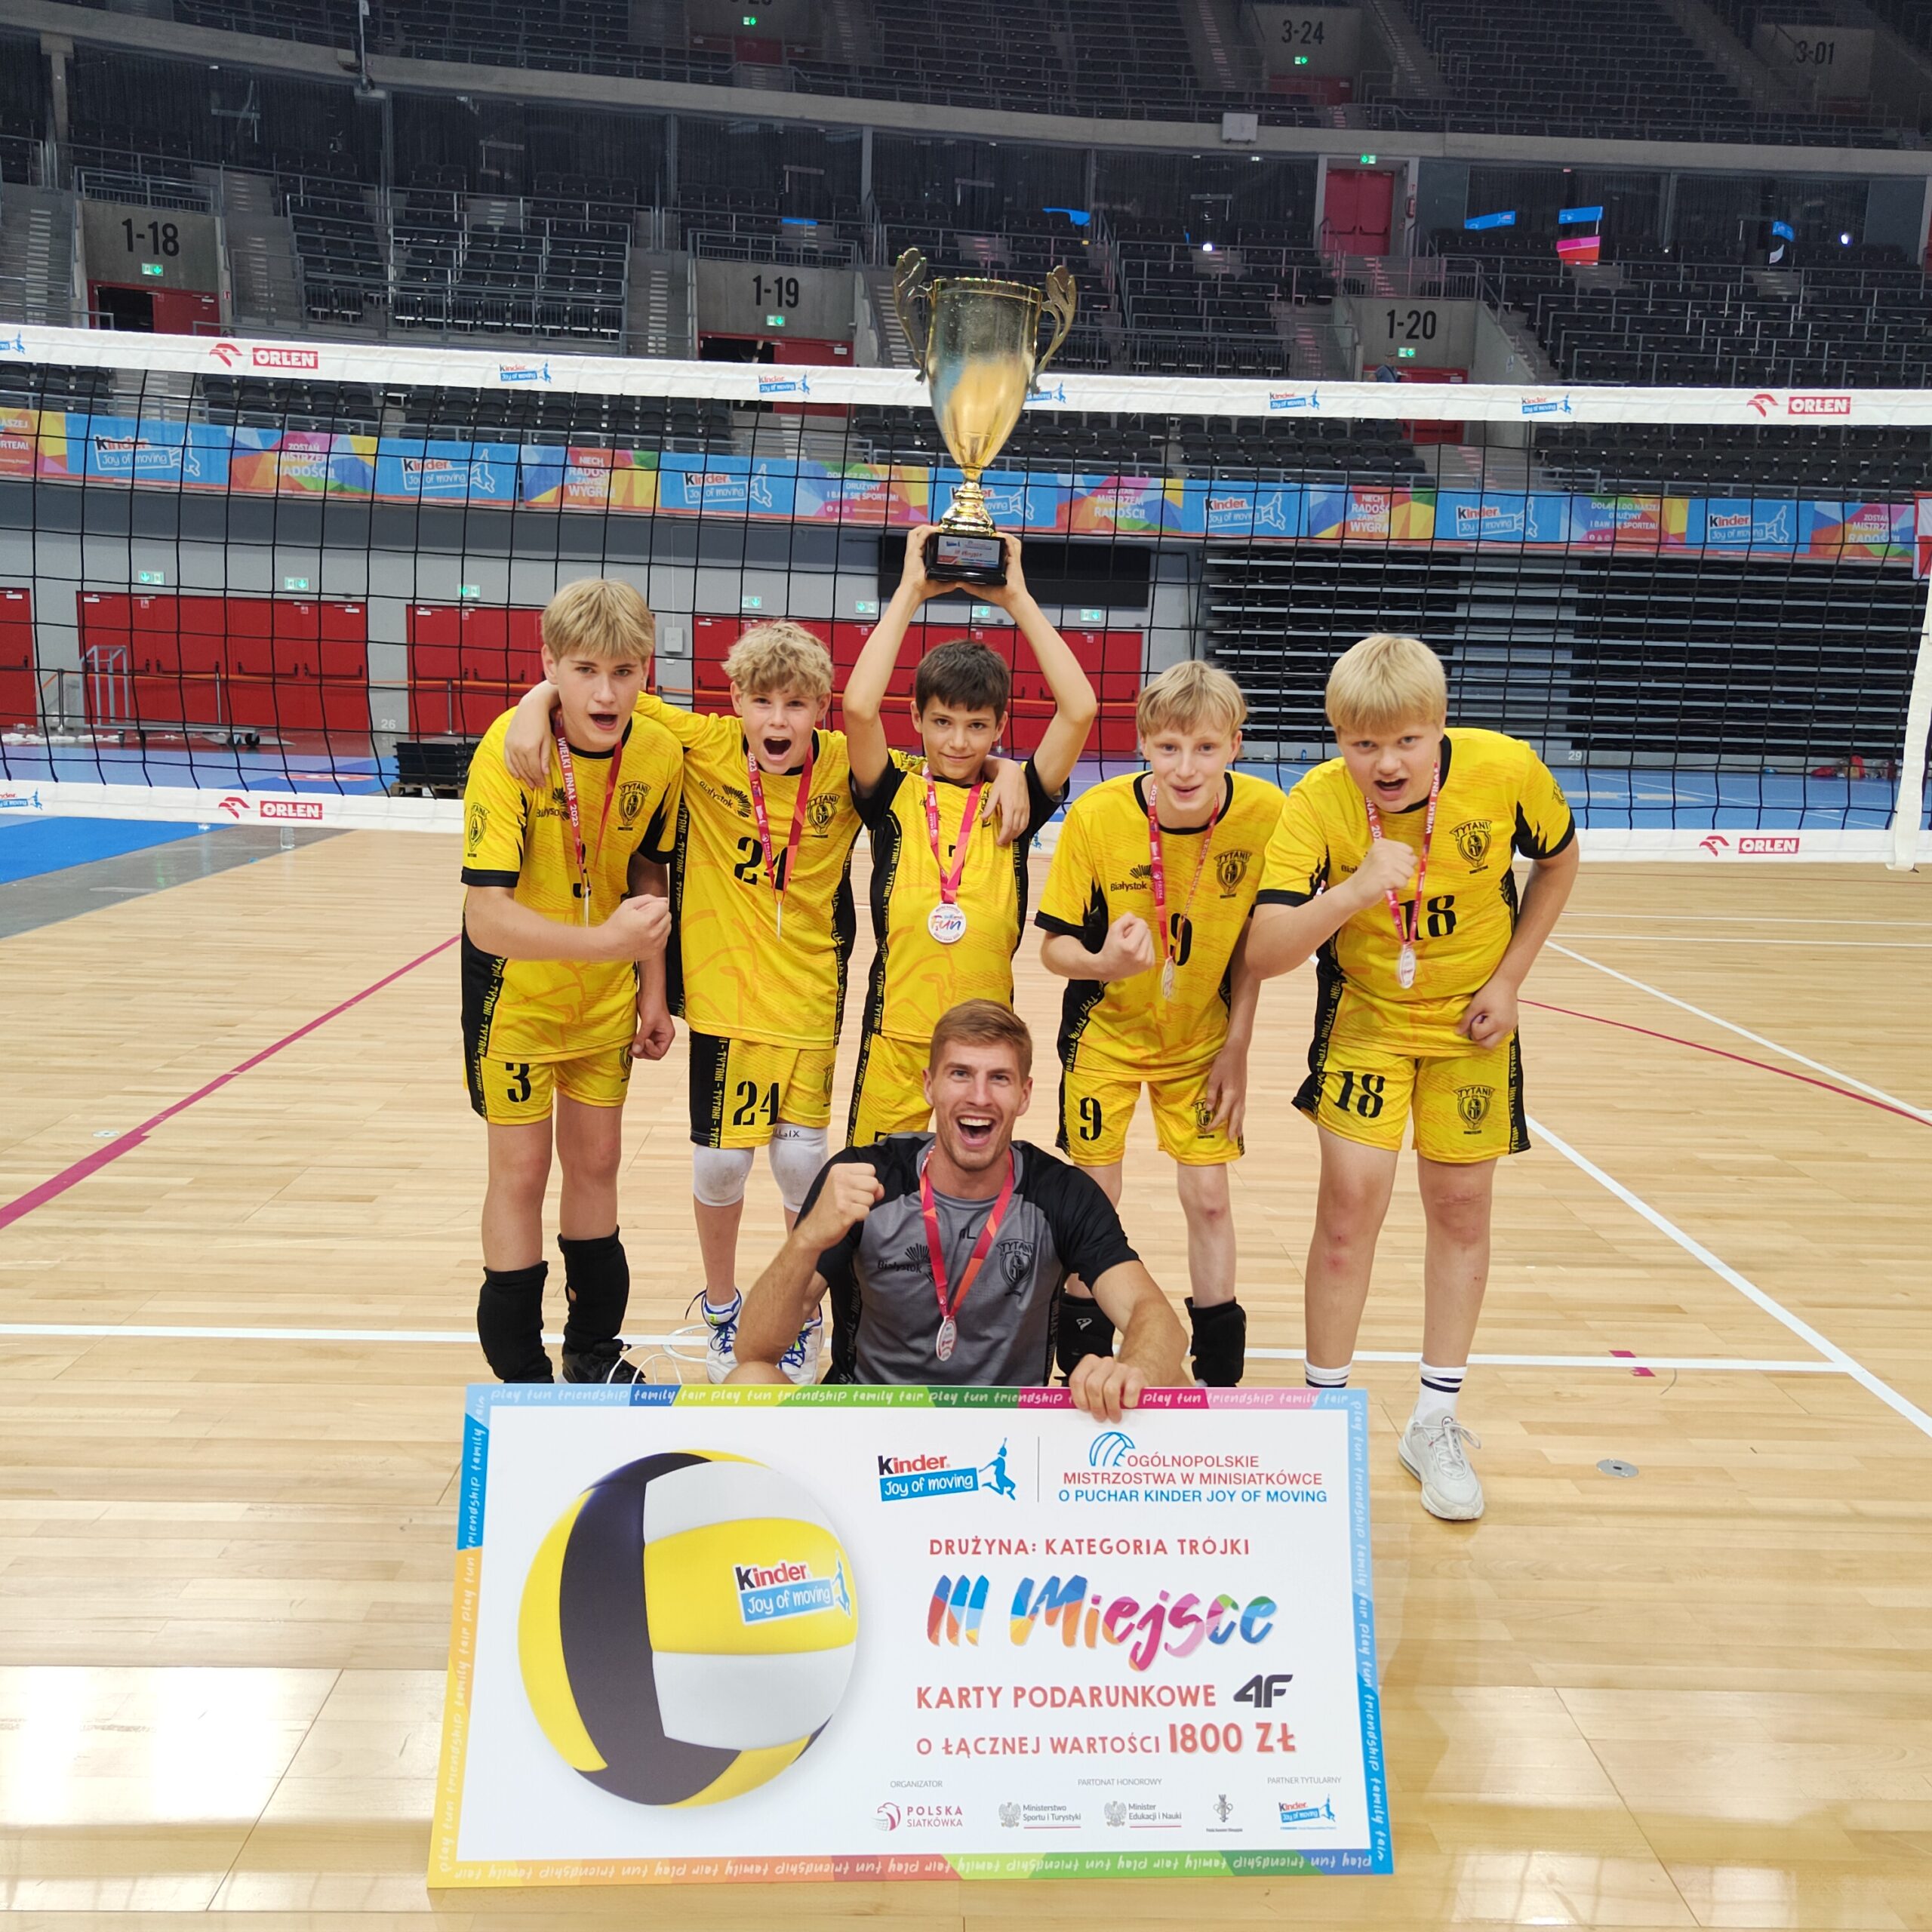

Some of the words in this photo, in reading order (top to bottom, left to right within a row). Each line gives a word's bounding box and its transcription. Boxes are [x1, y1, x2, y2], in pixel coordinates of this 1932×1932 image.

[1282, 20, 1324, 45] 3-24
[122, 217, 180, 257] 1-18
[752, 274, 800, 309] 1-19
[1386, 309, 1437, 340] 1-20
[255, 349, 315, 367] ORLEN
[1790, 398, 1848, 413] ORLEN
[103, 454, 120, 467] Joy
[404, 458, 448, 472] kinder
[436, 472, 466, 485] moving
[685, 472, 730, 486] kinder
[717, 488, 745, 499] moving
[1204, 498, 1245, 512] kinder
[1457, 506, 1498, 519] kinder
[1709, 515, 1749, 528] kinder
[1737, 528, 1763, 538] movng
[380, 718, 396, 730] 26
[557, 737, 571, 768] WIELKI
[1568, 750, 1583, 761] 29
[565, 772, 577, 801] FINAŁ
[621, 783, 648, 793] TYTANI
[263, 802, 320, 820] ORLEN
[570, 804, 579, 827] 2023
[1426, 801, 1436, 834] WIELKI
[1454, 821, 1491, 837] TYTANI
[1743, 838, 1796, 852] ORLEN
[1214, 851, 1251, 863] TYTANI
[1110, 879, 1147, 892] Białystok
[1398, 895, 1457, 943] 18
[1169, 912, 1192, 967] 9
[714, 1051, 727, 1081] TYTANI
[505, 1063, 531, 1103] 3
[1336, 1070, 1386, 1118] 18
[1458, 1087, 1491, 1097] TYTANI
[711, 1089, 723, 1119] TYTANI
[732, 1081, 780, 1126] 24
[1079, 1097, 1102, 1141] 9
[999, 1241, 1034, 1254] TYTANI
[634, 1389, 676, 1402] family
[711, 1390, 740, 1404] play
[777, 1389, 847, 1403] friendship
[853, 1390, 894, 1404] family
[899, 1390, 924, 1401] fair
[928, 1392, 958, 1405] play
[964, 1392, 989, 1403] fun
[993, 1392, 1063, 1405] friendship
[1143, 1393, 1172, 1407] play
[1177, 1393, 1201, 1404] fun
[877, 1453, 949, 1476] kinder
[1127, 1451, 1260, 1469] OGÓLNOPOLSKIE
[884, 1478, 910, 1498] Joy
[911, 1475, 925, 1493] of
[928, 1472, 974, 1491] moving
[1063, 1472, 1177, 1486] MISTRZOSTWA
[1180, 1472, 1196, 1485] W
[1198, 1468, 1323, 1486] MINISIATKÓWCE
[1058, 1489, 1070, 1503] O
[1074, 1489, 1140, 1503] PUCHAR
[1144, 1489, 1202, 1503] KINDER
[1205, 1489, 1237, 1503] JOY
[1241, 1489, 1262, 1503] OF
[1266, 1489, 1327, 1503] MOVING
[929, 1535, 1037, 1556] DRUŻYNA:
[1045, 1538, 1168, 1555] KATEGORIA
[1177, 1536, 1250, 1555] TRÓJKI
[735, 1562, 807, 1591] kinder
[747, 1596, 774, 1615] Joy
[776, 1589, 791, 1609] of
[793, 1586, 831, 1607] moving
[927, 1574, 989, 1647] III
[1009, 1574, 1278, 1672] Miejsce
[916, 1686, 1003, 1709] KARTY
[1013, 1684, 1217, 1709] PODARUNKOWE
[1233, 1674, 1294, 1709] 4F
[916, 1738, 932, 1755] O
[941, 1736, 1041, 1759] ŁĄCZNEJ
[1048, 1732, 1161, 1754] WARTOŚCI
[1168, 1722, 1244, 1754] 1800
[1255, 1721, 1297, 1753] ZŁ
[890, 1780, 943, 1788] ORGANIZATOR
[1116, 1778, 1163, 1786] HONOROWY
[1267, 1776, 1299, 1785] PARTNER
[1300, 1776, 1342, 1785] TYTULARNY
[907, 1805, 963, 1817] POLSKA
[1023, 1804, 1067, 1812] Ministerstwo
[1128, 1802, 1156, 1811] Minister
[1278, 1801, 1306, 1811] kinder
[906, 1817, 963, 1828] SIATKÓWKA
[1023, 1813, 1045, 1822] Sportu
[1050, 1813, 1081, 1822] Turystyki
[1128, 1811, 1157, 1821] Edukacji
[1161, 1811, 1183, 1820] Nauki
